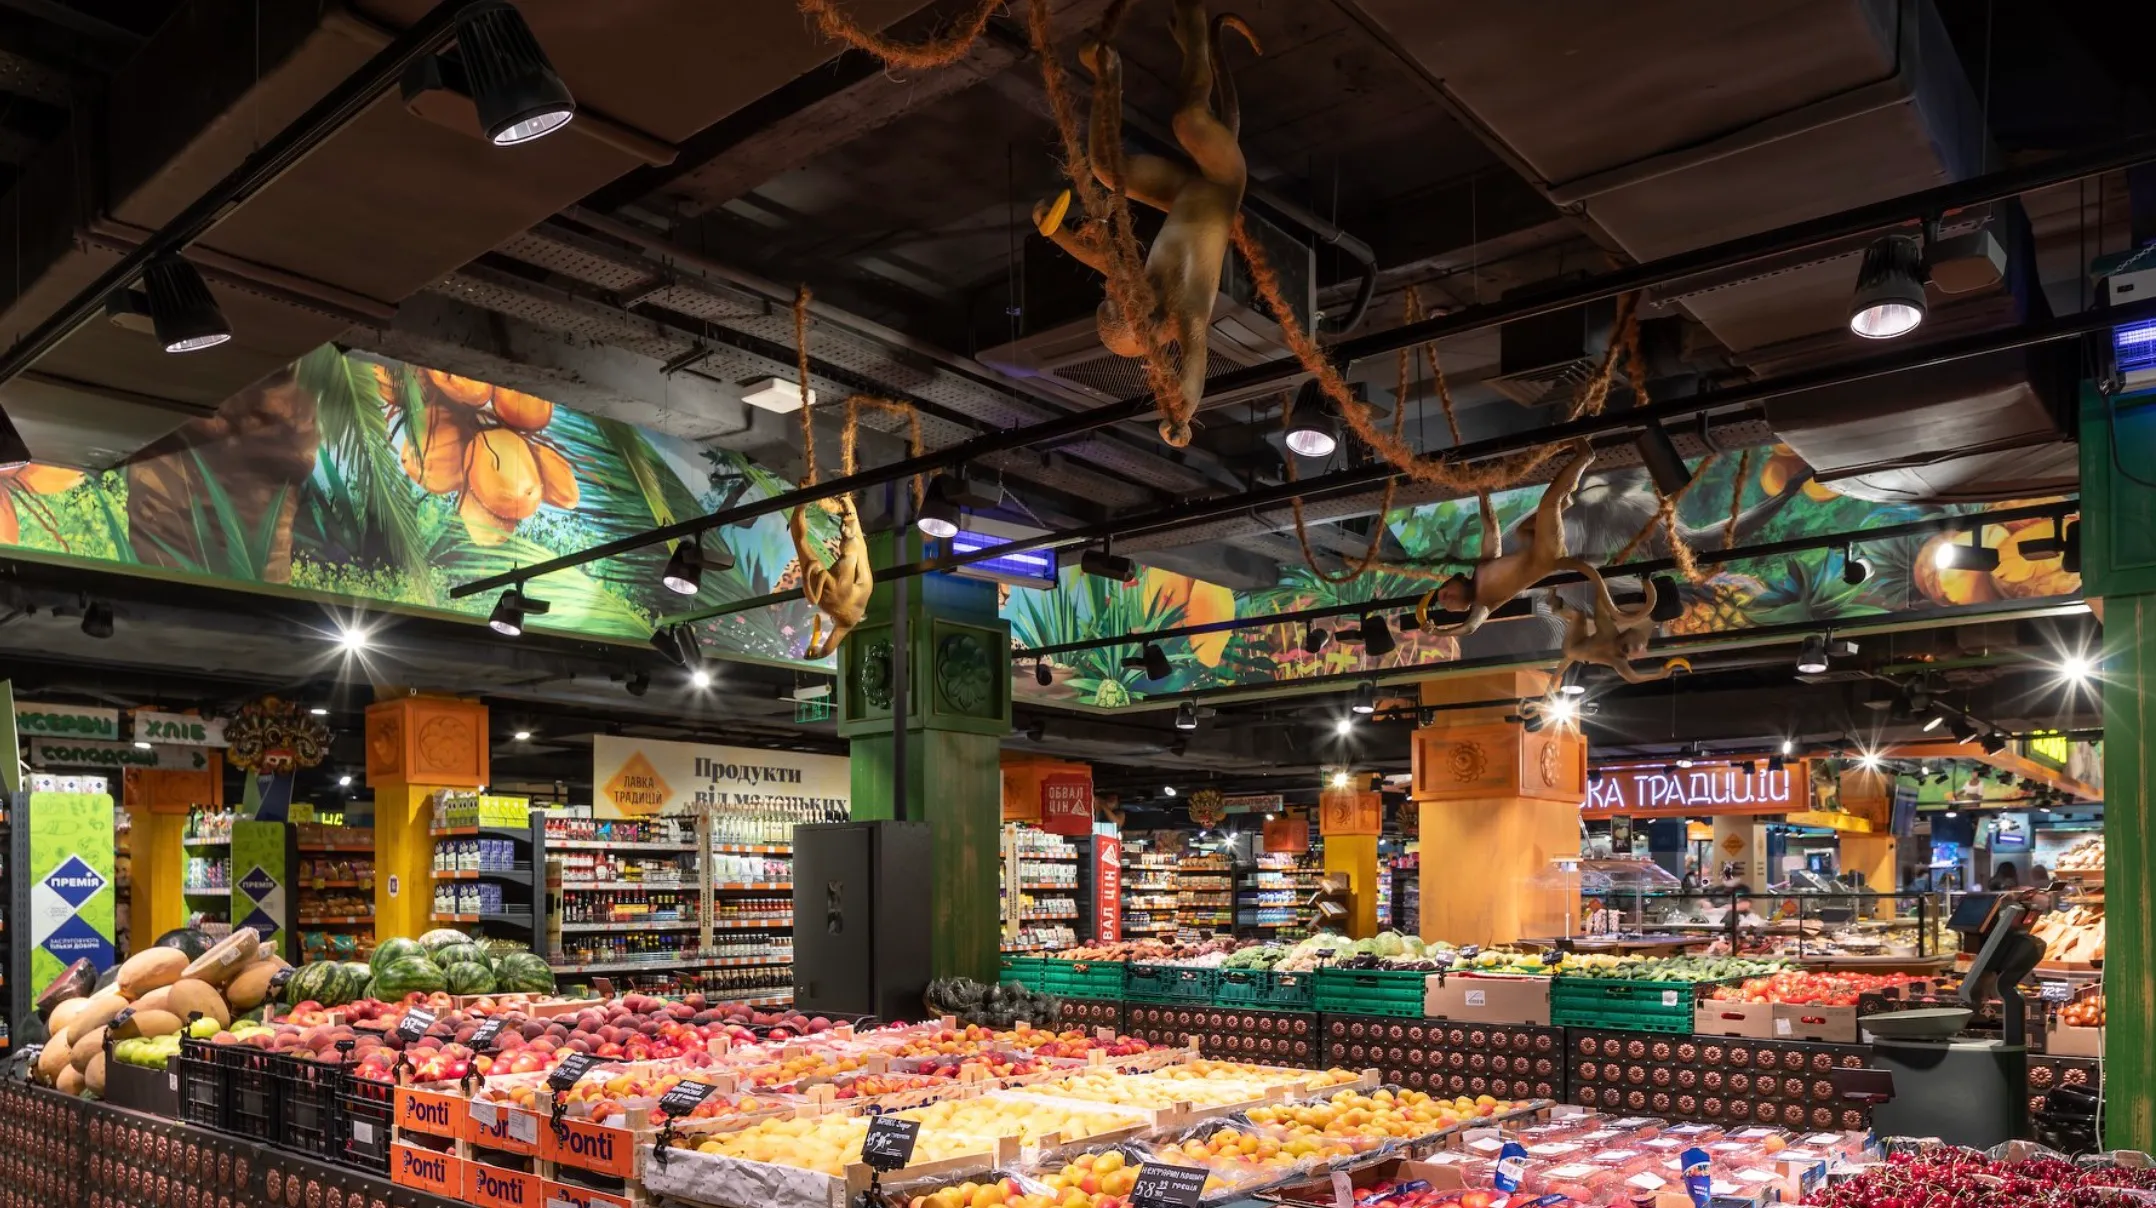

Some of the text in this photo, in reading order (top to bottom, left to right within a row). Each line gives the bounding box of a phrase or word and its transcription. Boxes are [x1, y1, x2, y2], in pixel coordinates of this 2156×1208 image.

[623, 775, 655, 789] ЛАВКА
[695, 757, 801, 786] Продукти
[614, 791, 662, 806] ТРАДИЦІЙ
[1049, 786, 1084, 800] ОБВАЛ
[1579, 777, 1625, 808] КА
[1049, 801, 1069, 815] ЦІН
[51, 872, 99, 887] ПРЕМІЯ
[242, 876, 274, 889] ПРЕМІЯ
[407, 1095, 449, 1126] Ponti
[557, 1122, 615, 1161] Ponti
[403, 1149, 445, 1183] Ponti
[477, 1169, 523, 1204] Ponti
